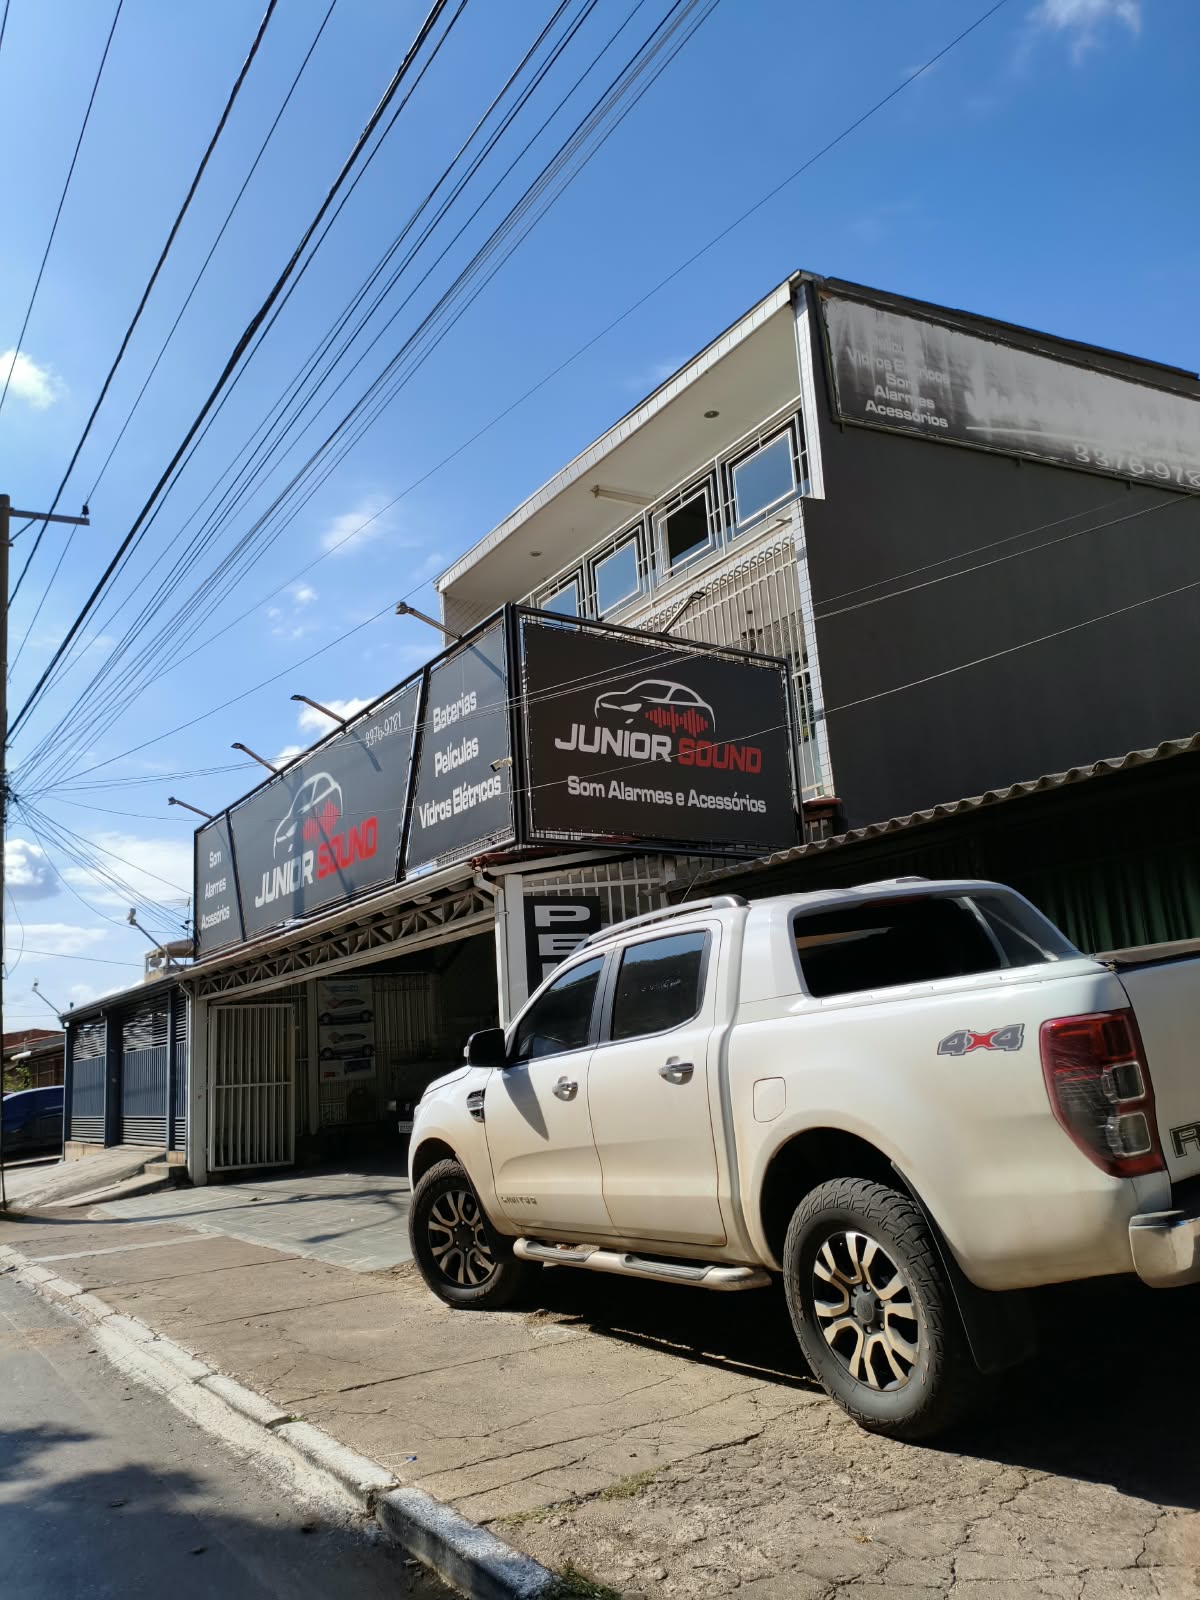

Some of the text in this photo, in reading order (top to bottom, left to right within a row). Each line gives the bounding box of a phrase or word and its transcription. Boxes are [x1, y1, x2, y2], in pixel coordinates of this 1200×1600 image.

[865, 400, 949, 428] Acessórios
[433, 691, 477, 733] Baterias
[435, 737, 479, 777] Películas
[555, 723, 762, 774] JUNIOR SOUND
[420, 775, 501, 829] Vidros Elétricos
[568, 775, 767, 813] Som Alarmes e Acessórios
[209, 851, 222, 868] Som
[255, 816, 377, 908] JUNIOR SOUND
[205, 878, 226, 900] Alarmes
[201, 905, 230, 930] Acessórios
